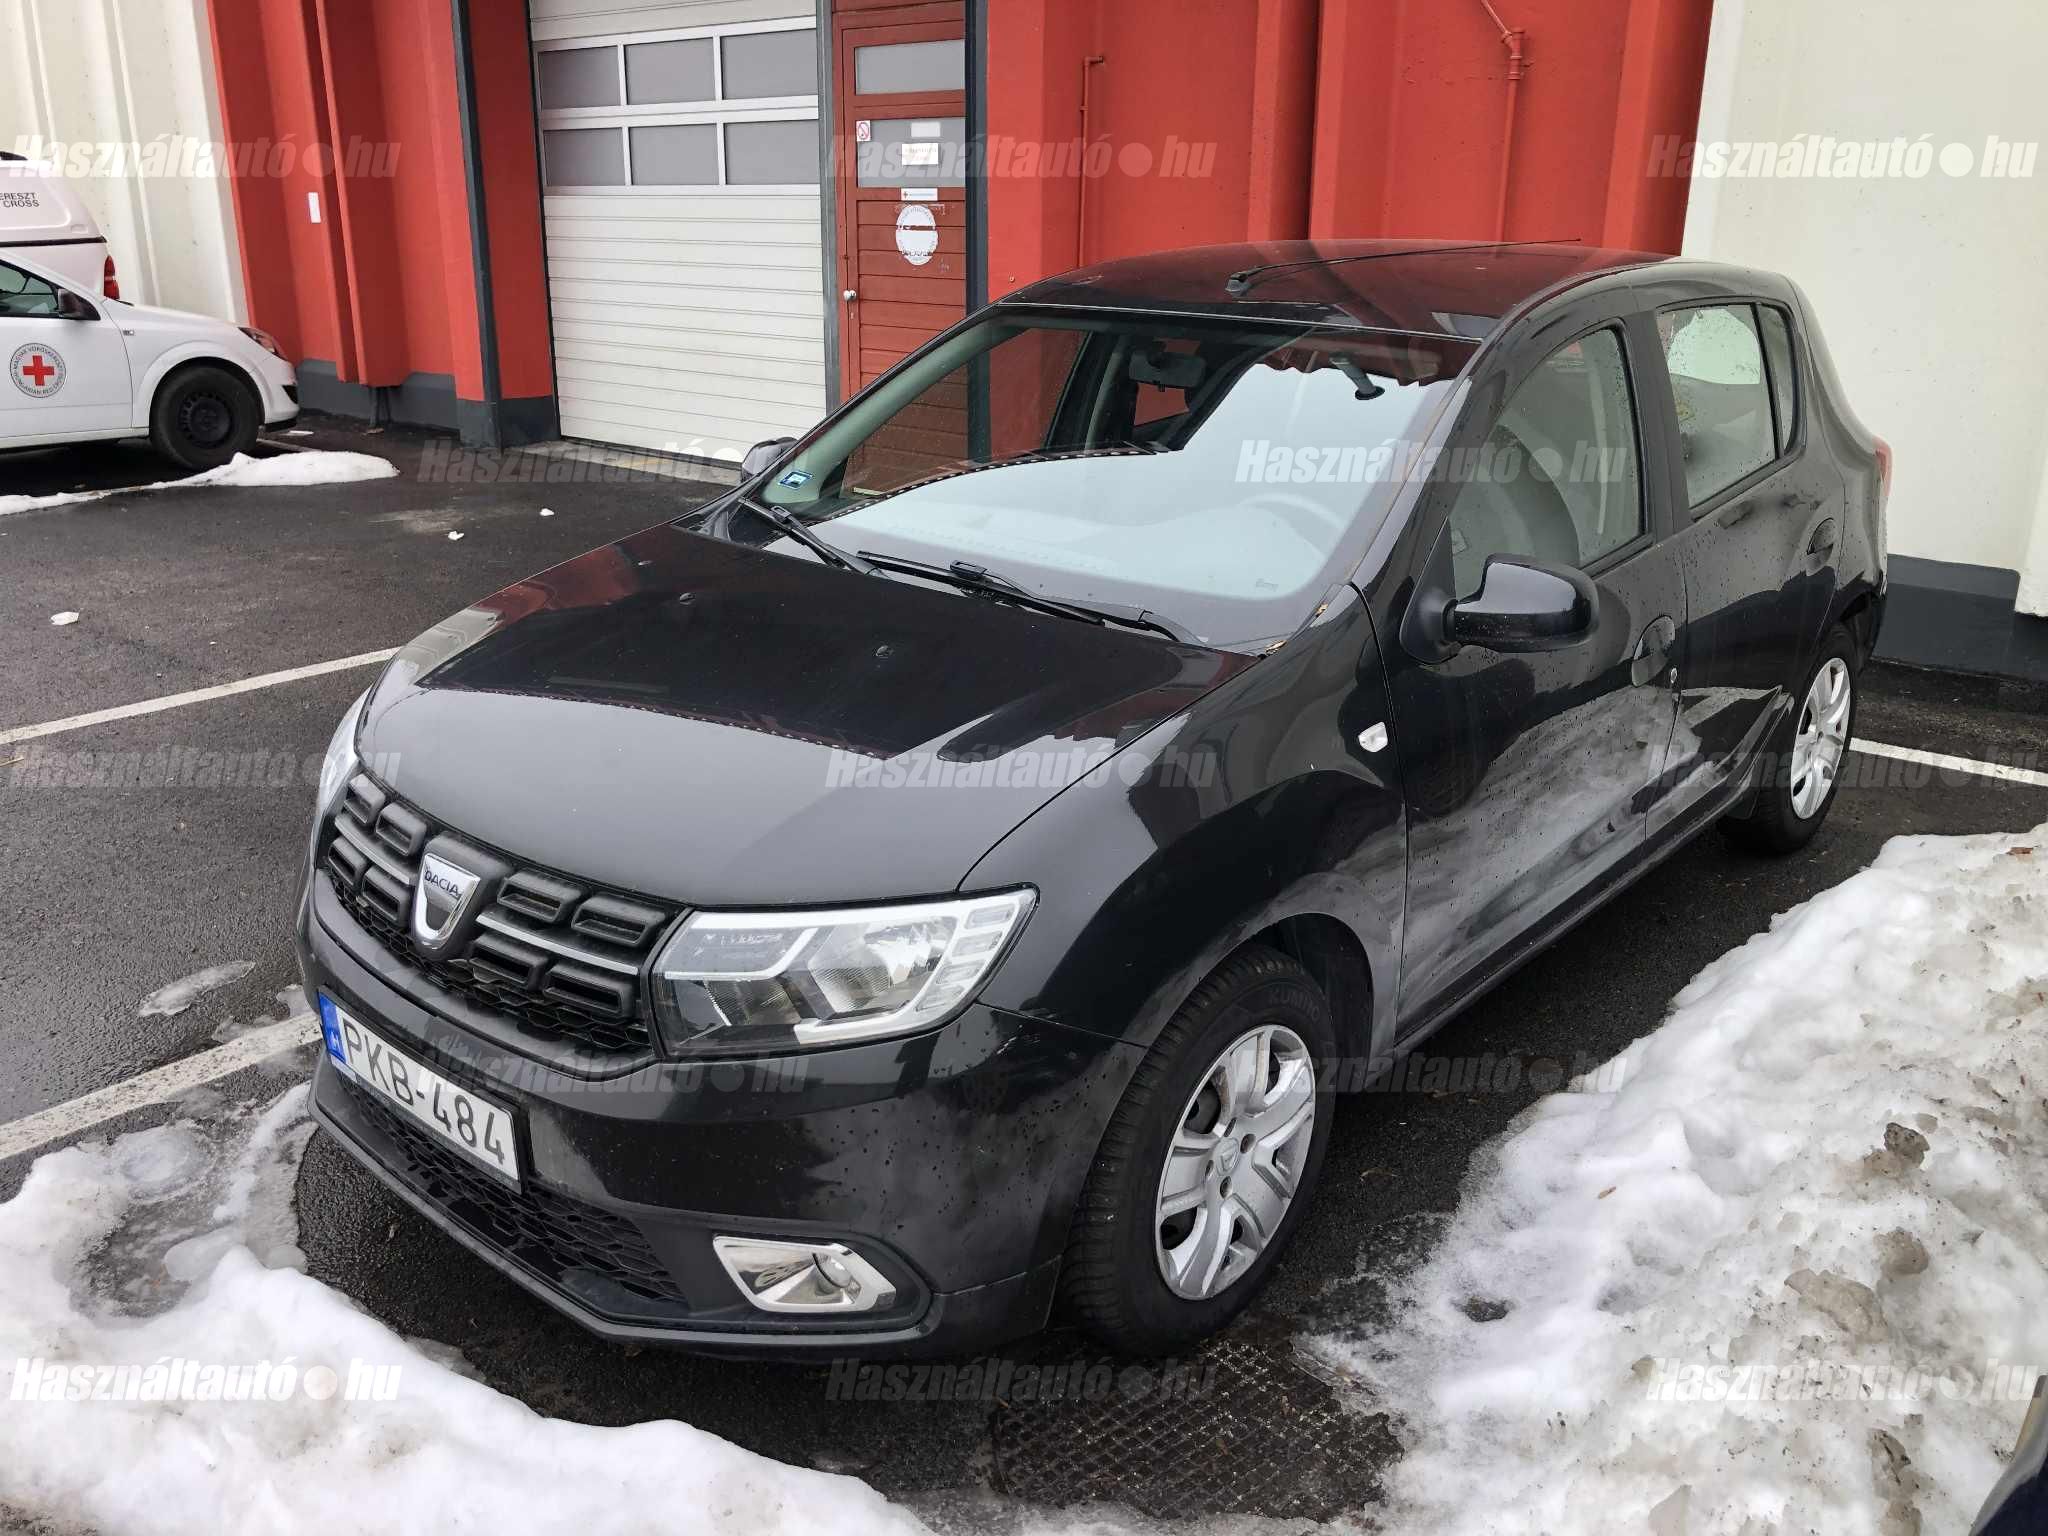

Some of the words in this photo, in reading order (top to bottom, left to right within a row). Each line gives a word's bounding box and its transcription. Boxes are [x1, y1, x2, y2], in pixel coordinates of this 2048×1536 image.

[3, 199, 40, 208] CROSS
[425, 870, 459, 896] DACIA
[342, 1018, 505, 1165] PKB-484
